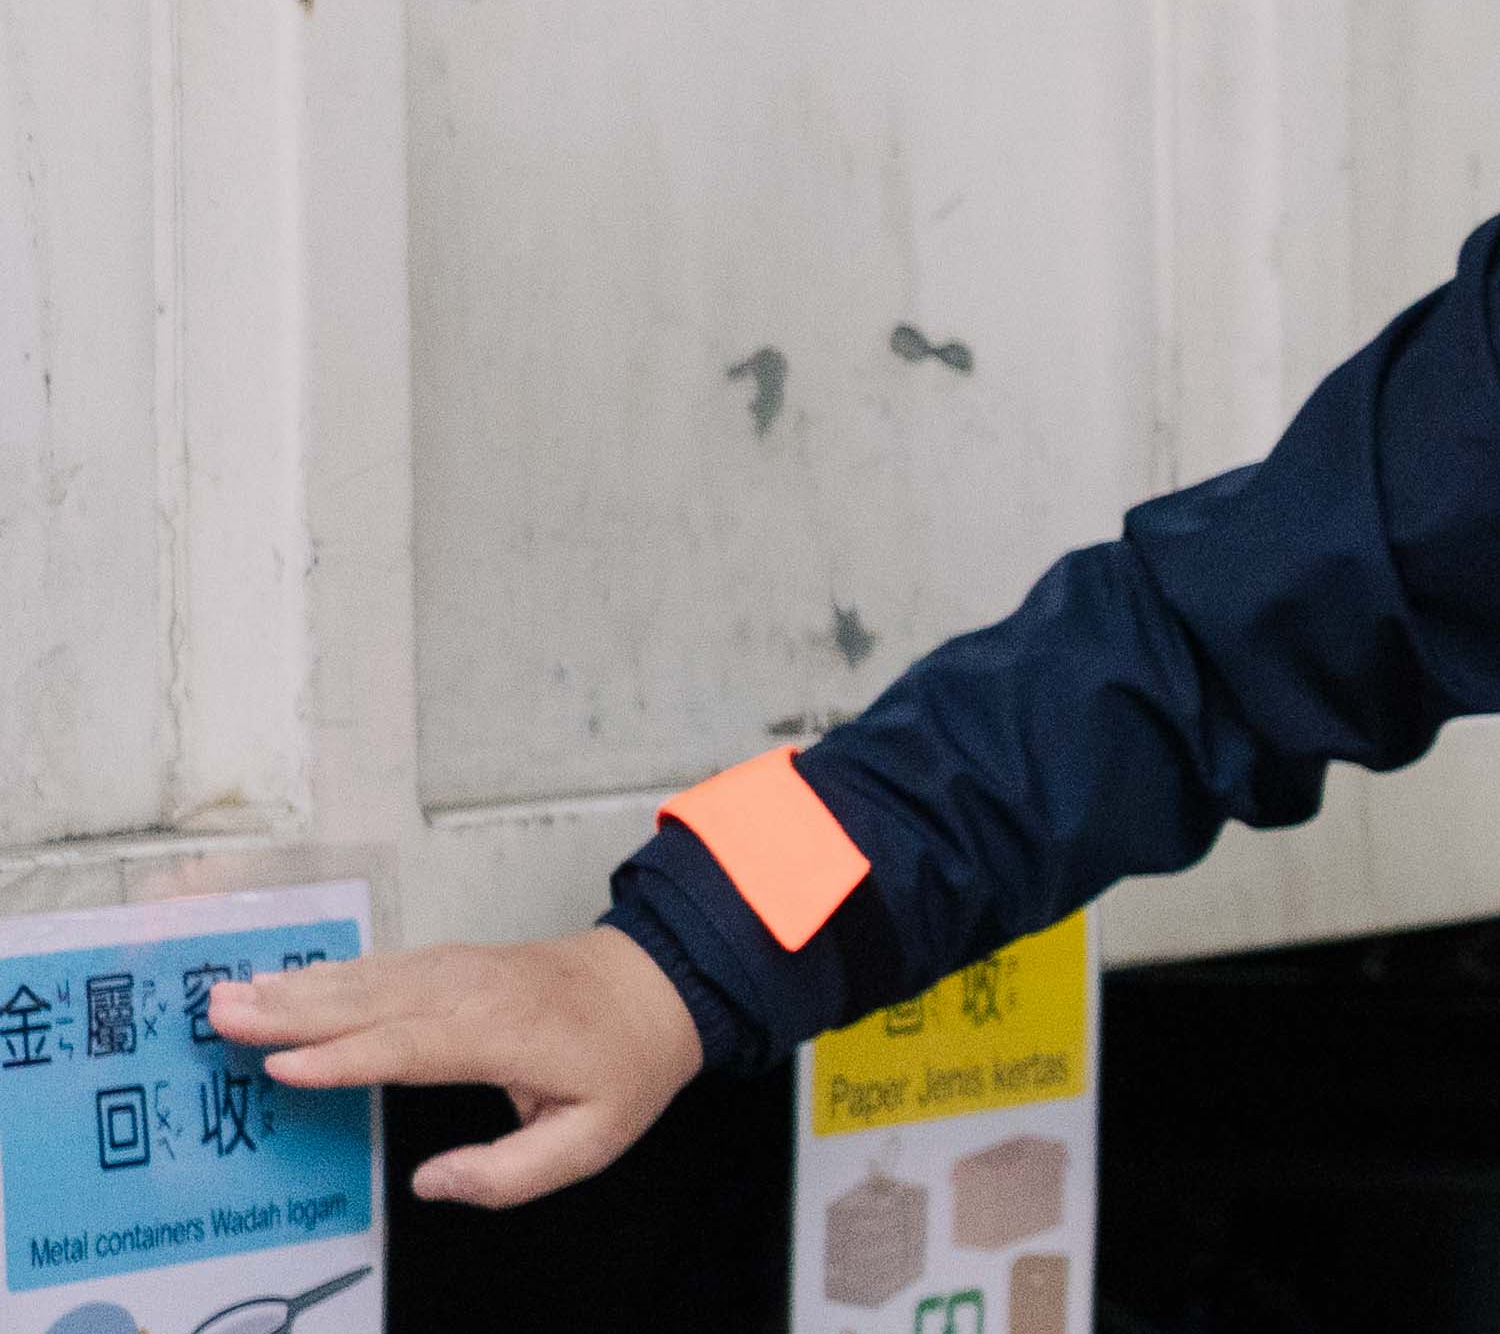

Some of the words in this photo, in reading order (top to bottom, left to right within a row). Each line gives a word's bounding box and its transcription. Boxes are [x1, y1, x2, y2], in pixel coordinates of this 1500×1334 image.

[96, 1069, 258, 1170] 回收
[830, 1073, 910, 1124] Paper
[30, 1232, 88, 1268] Metal
[95, 1217, 206, 1257] containers
[211, 1203, 281, 1238] Wadah
[287, 1192, 349, 1229] logam
